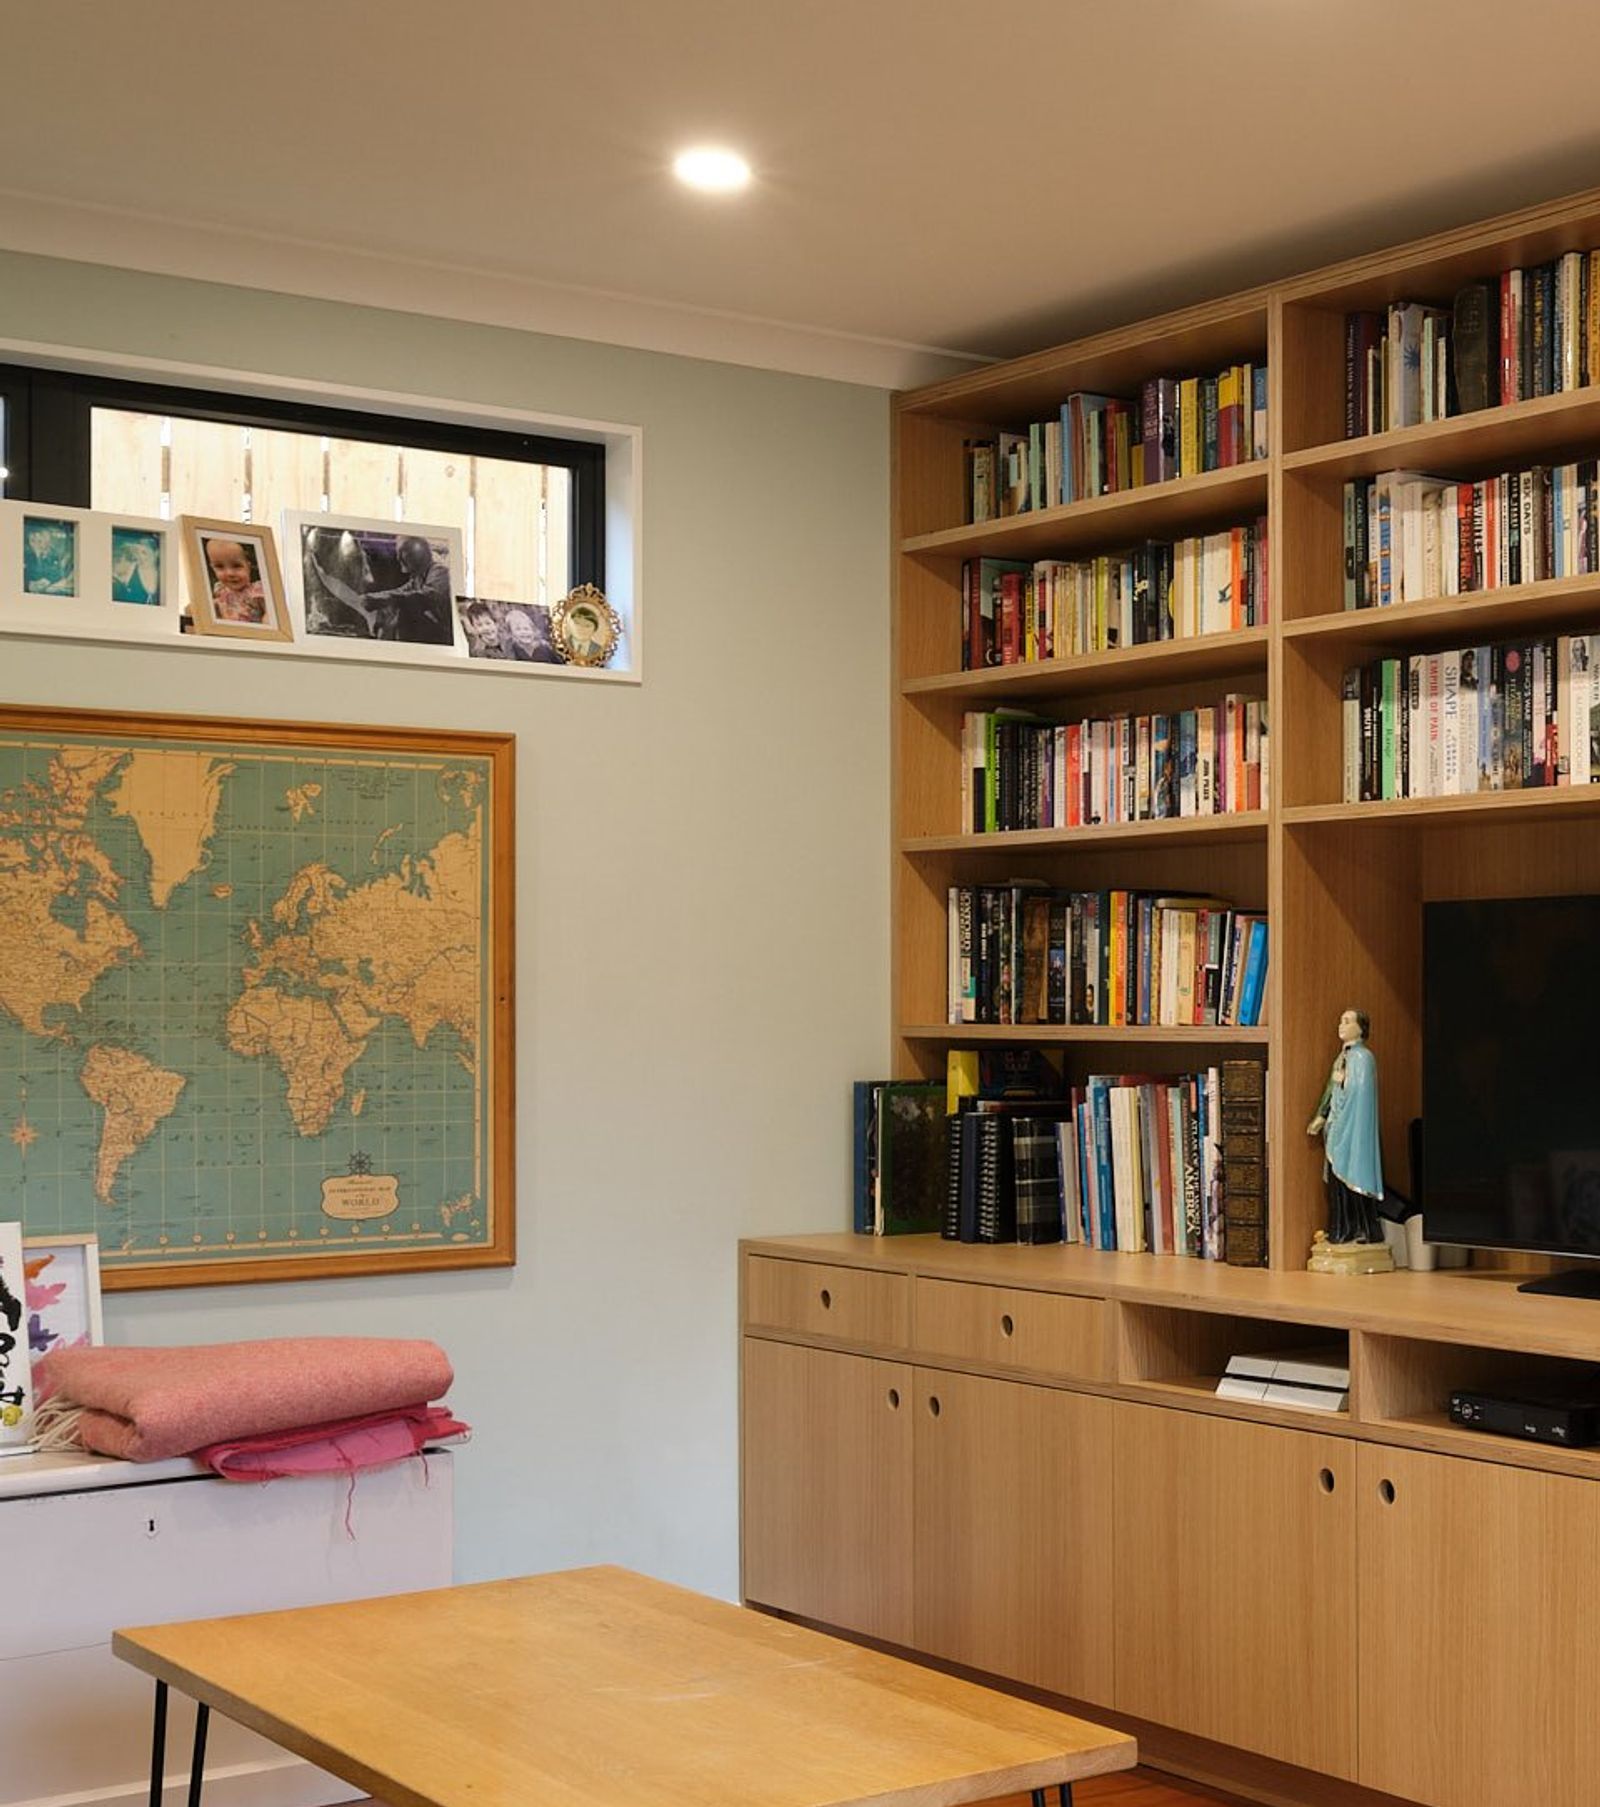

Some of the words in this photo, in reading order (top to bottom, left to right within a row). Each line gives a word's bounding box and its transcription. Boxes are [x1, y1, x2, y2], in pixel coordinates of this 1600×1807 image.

[1523, 477, 1531, 500] SIX
[1474, 507, 1484, 554] WHITES
[1523, 502, 1531, 535] DAYS
[1429, 659, 1439, 697] EMPIRE
[1445, 666, 1458, 719] SHAPE
[1429, 701, 1439, 714] OF
[1429, 716, 1439, 742] PAIN
[1185, 1163, 1195, 1234] AMERICA
